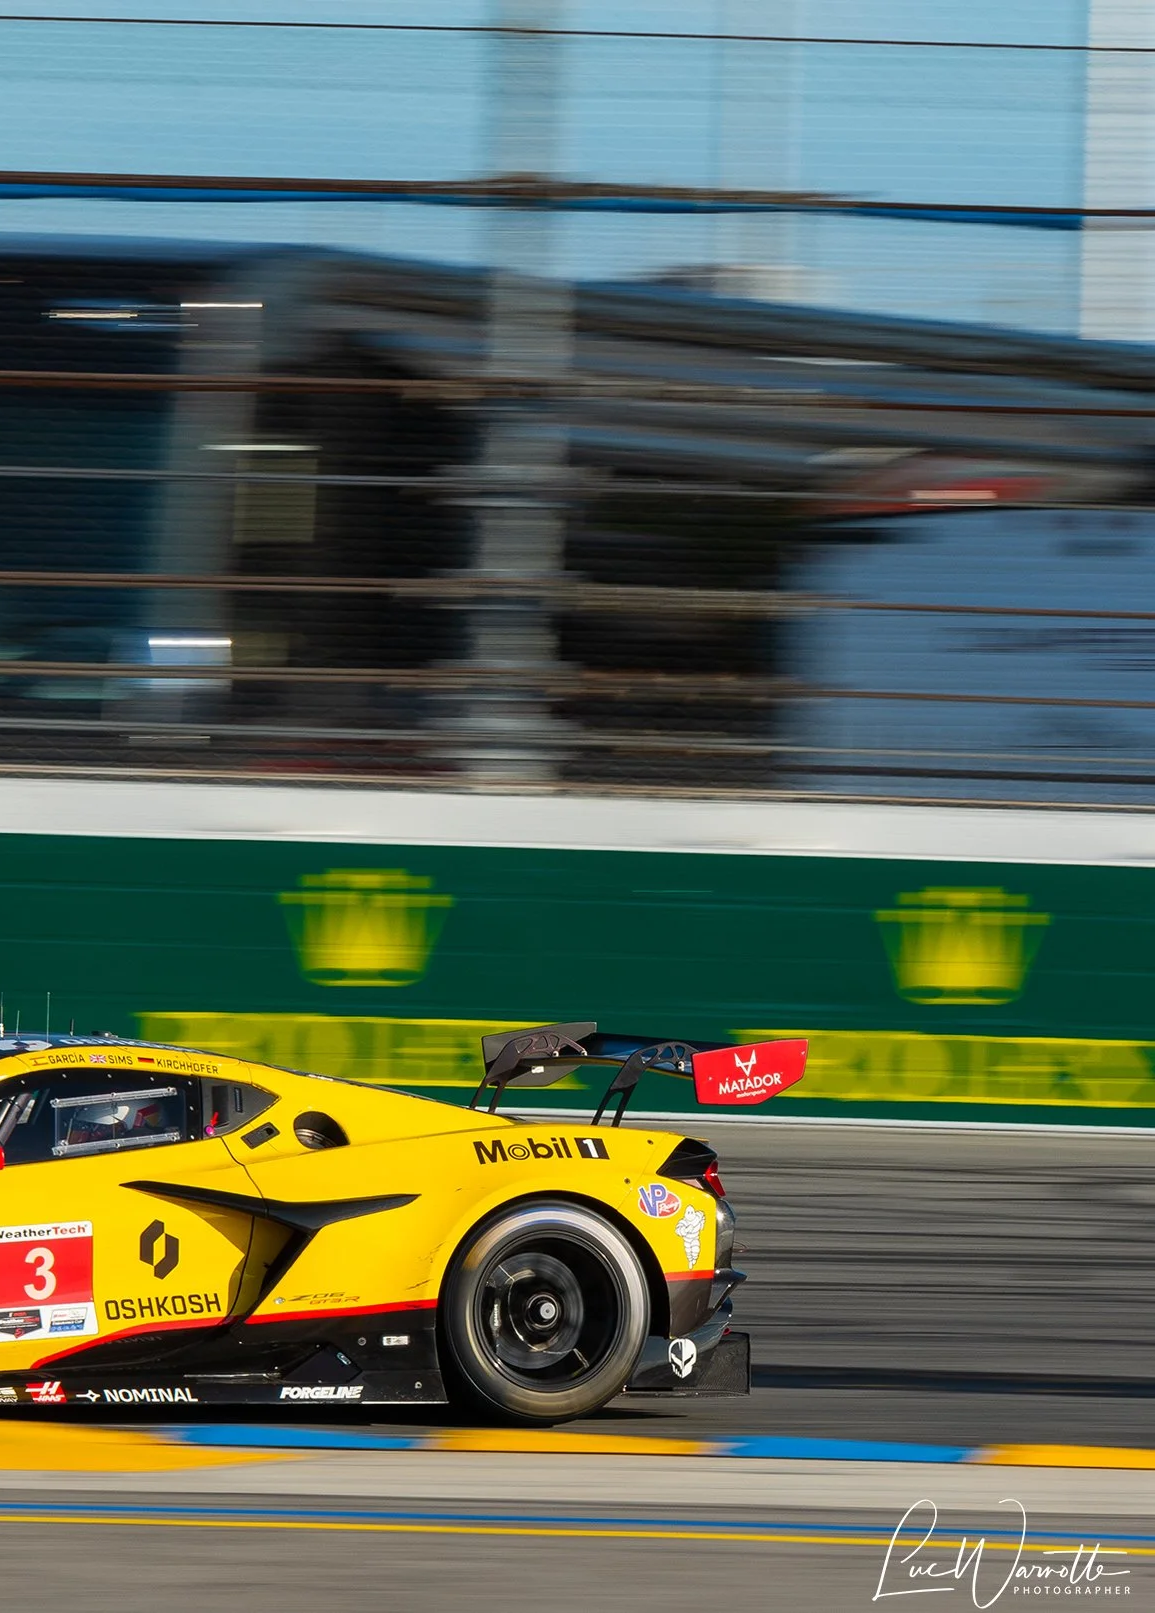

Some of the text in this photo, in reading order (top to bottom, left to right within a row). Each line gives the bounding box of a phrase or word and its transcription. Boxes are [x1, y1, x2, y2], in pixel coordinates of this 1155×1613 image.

[108, 1056, 133, 1065] SIMS
[156, 1059, 218, 1074] KIRCHHOFER
[718, 1073, 782, 1095] MATADOR
[473, 1137, 599, 1164] Mobil 1
[639, 1185, 666, 1216] VP
[24, 1247, 56, 1300] 3
[105, 1293, 222, 1320] OSHKOSH
[549, 1357, 606, 1370] MOTUL
[103, 1388, 198, 1402] NOMINAL
[280, 1386, 363, 1399] FORGELINE
